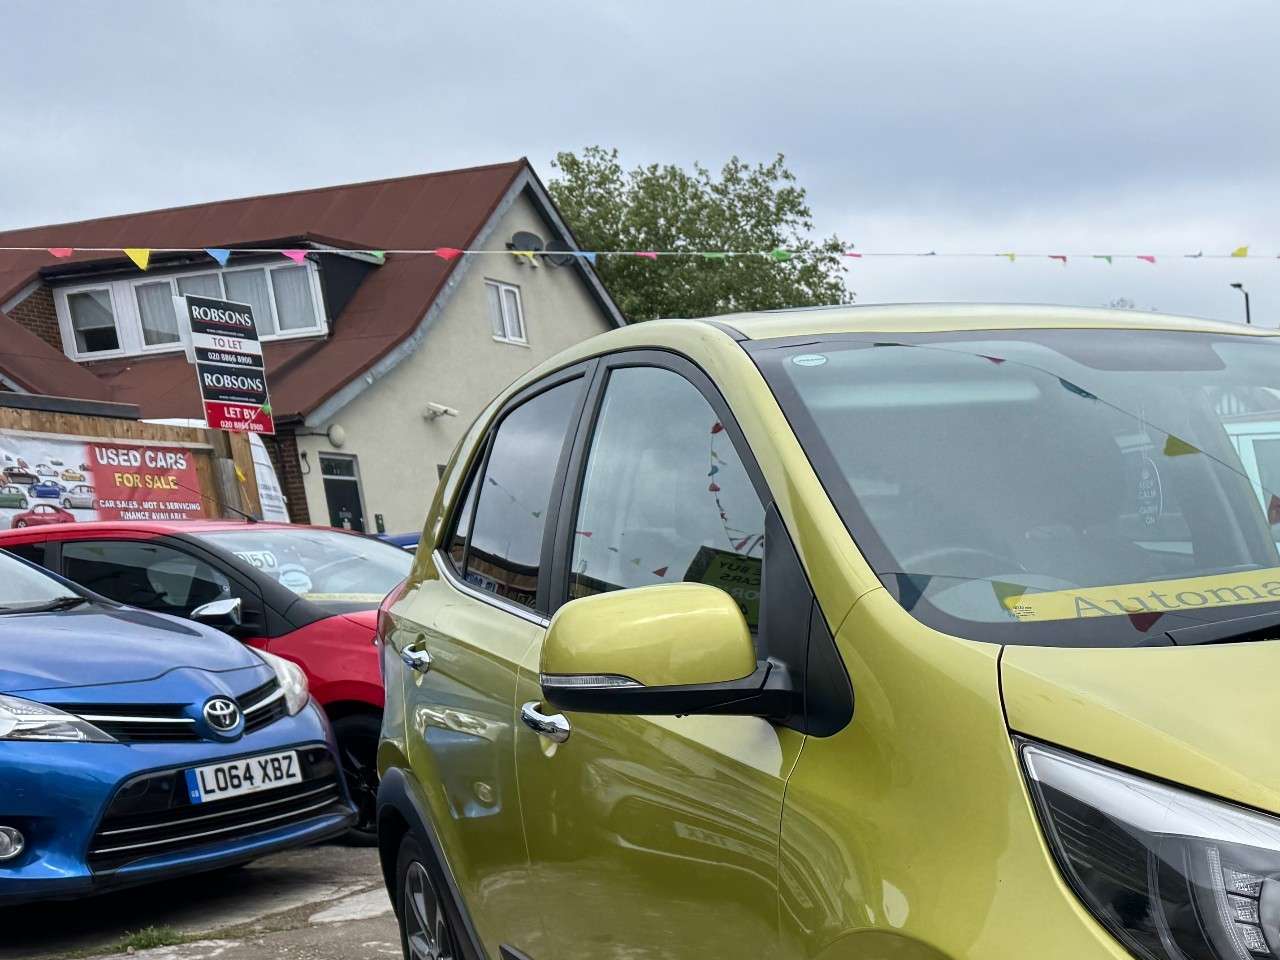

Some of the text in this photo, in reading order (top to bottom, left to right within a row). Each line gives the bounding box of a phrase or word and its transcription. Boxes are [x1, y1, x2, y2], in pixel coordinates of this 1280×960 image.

[191, 305, 252, 327] ROBSONS
[212, 337, 243, 350] TO LET
[208, 352, 220, 361] 020
[203, 373, 263, 392] ROBSONS
[224, 406, 256, 420] LET BY
[220, 420, 233, 428] 020
[95, 447, 187, 470] USED CARS
[114, 472, 178, 489] FOR SALE
[99, 500, 116, 509] CAR
[166, 502, 201, 511] SERVICING
[258, 755, 296, 783] XBZ
